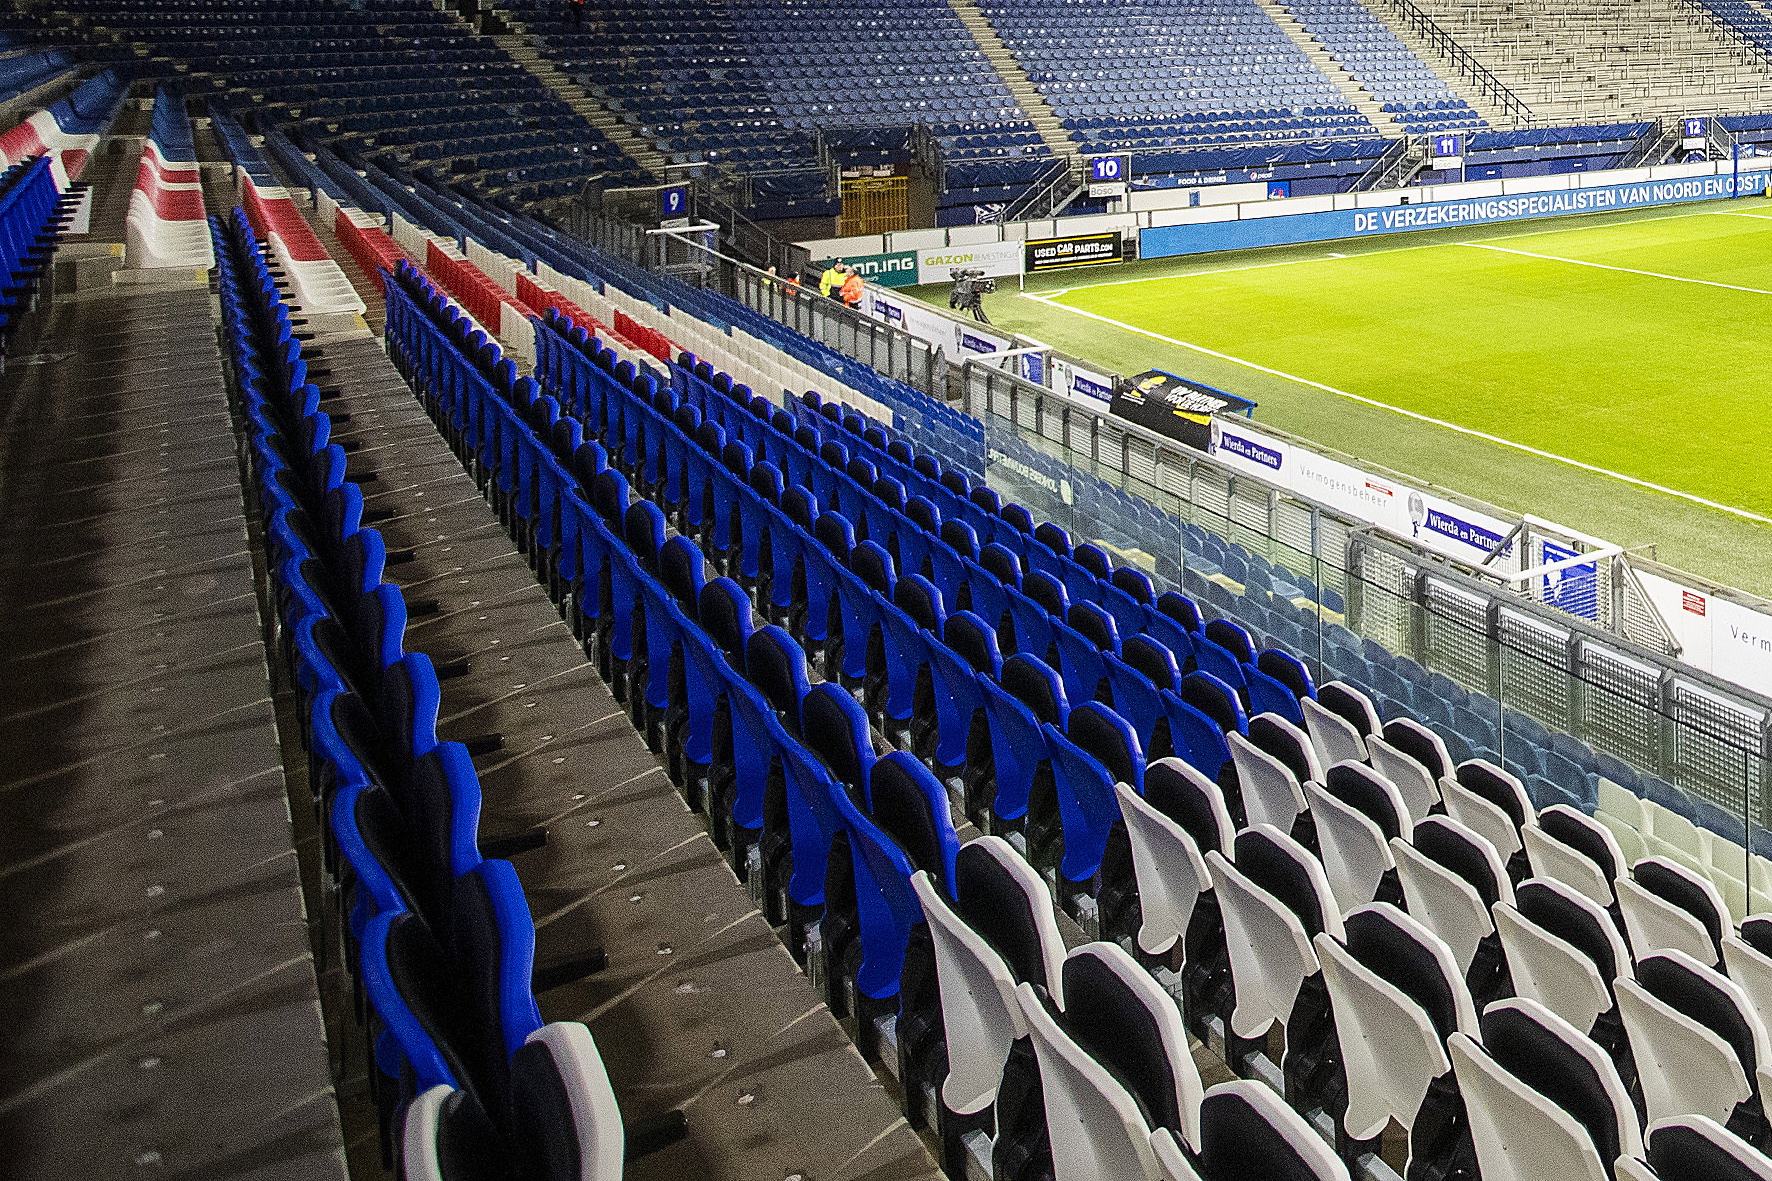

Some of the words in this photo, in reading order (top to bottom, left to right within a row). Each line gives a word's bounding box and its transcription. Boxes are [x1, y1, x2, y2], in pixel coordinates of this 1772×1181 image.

[1688, 121, 1701, 135] 12
[1441, 139, 1454, 154] 11
[1097, 160, 1117, 176] 10
[669, 192, 679, 211] 9
[1354, 213, 1378, 232] DE
[1381, 193, 1616, 228] VERZEKERINGSSPECIALISTEN
[1619, 188, 1651, 205] VAN
[1653, 183, 1703, 201] NOORD
[1705, 180, 1723, 196] EN
[1034, 248, 1056, 258] USED
[1057, 243, 1073, 253] CAR
[1075, 242, 1114, 254] PARTS.COM
[1075, 378, 1091, 394] Wierda
[1223, 436, 1245, 454] Wierda
[1251, 447, 1278, 466] Partners
[1300, 464, 1388, 508] Vermogensbeheer
[1430, 513, 1459, 536] Wierda
